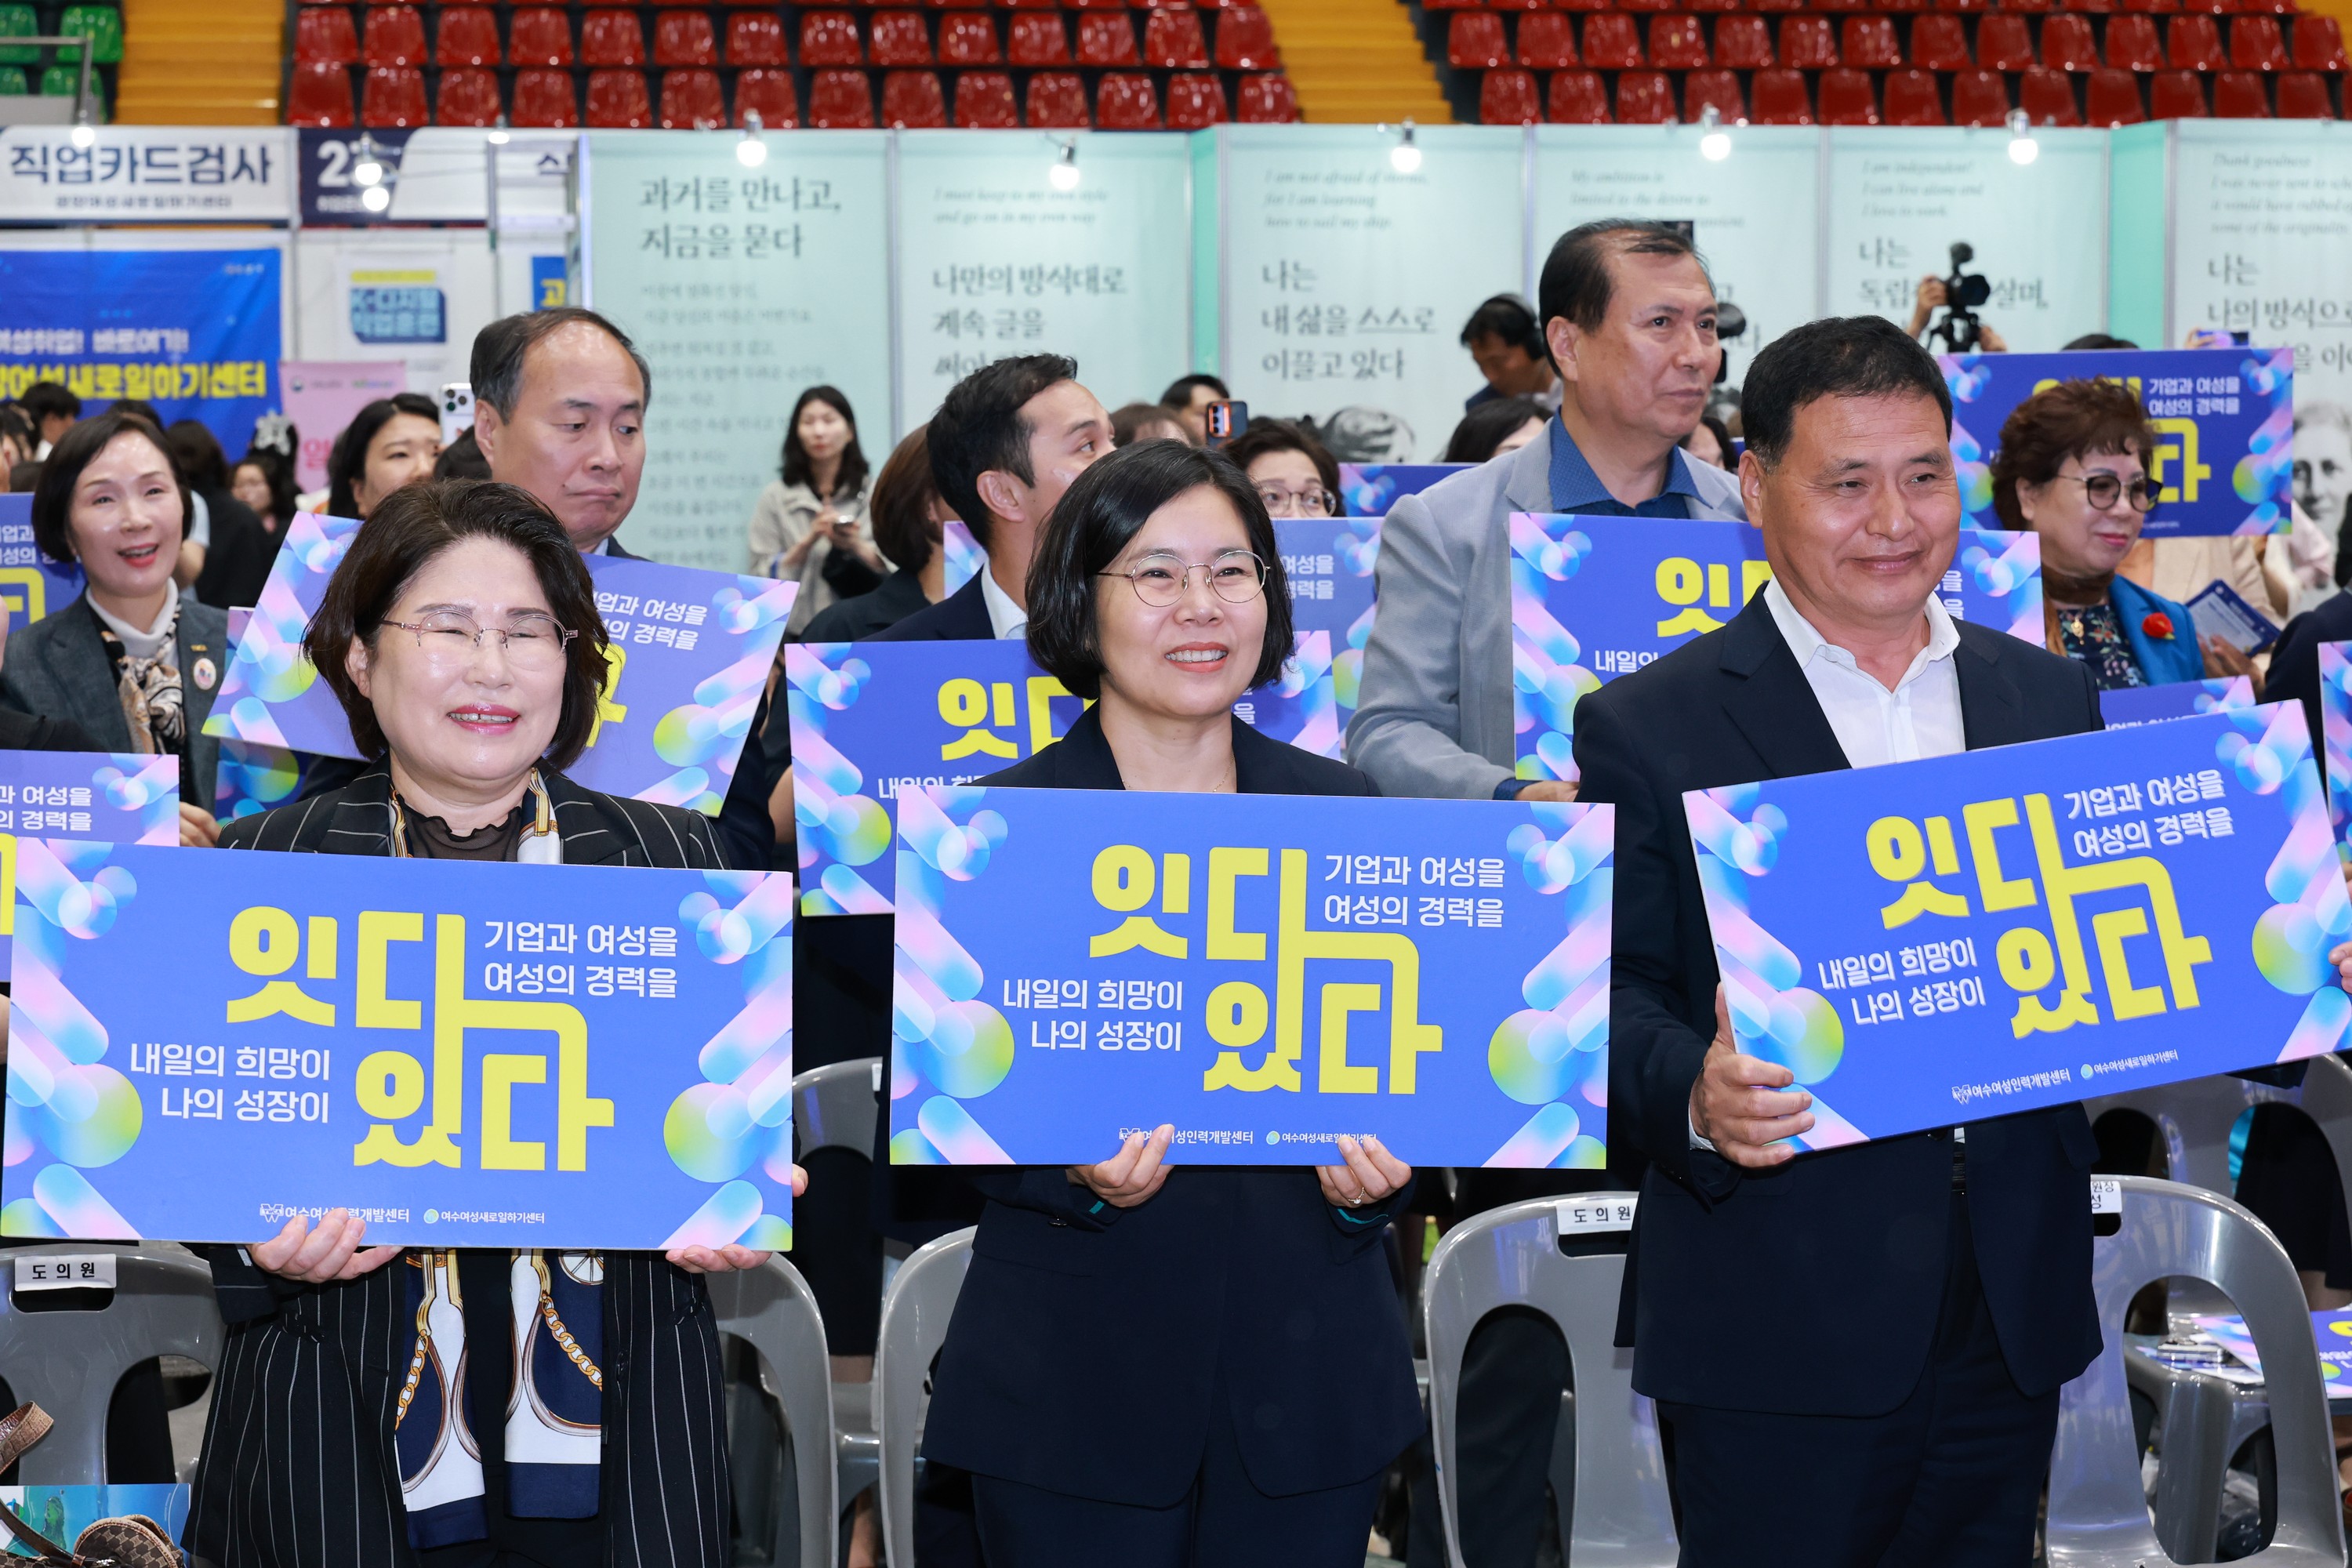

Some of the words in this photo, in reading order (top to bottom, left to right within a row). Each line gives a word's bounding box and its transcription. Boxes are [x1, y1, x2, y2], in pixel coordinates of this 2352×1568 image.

[11, 145, 273, 185] 직업카드검사
[640, 177, 732, 212] 과거를
[742, 177, 841, 212] 만나고,
[641, 223, 733, 260] 지금을
[744, 223, 803, 260] 묻다
[1859, 237, 1911, 269] 나는
[933, 263, 1013, 296] 나만의
[1019, 263, 1127, 296] 방식대로
[1262, 260, 1318, 291] 나는
[2208, 252, 2259, 286] 나는
[934, 309, 986, 339] 계속
[993, 309, 1046, 339] 글을
[1356, 307, 1438, 335] 스스로
[2208, 298, 2258, 328] 나의
[2264, 298, 2352, 331] 방식으
[1262, 349, 1345, 380] 이끌고
[1351, 349, 1406, 380] 있다
[0, 361, 267, 401] 여성새로일하기센터
[2149, 378, 2193, 396] 기업과
[2149, 399, 2193, 416] 여성의
[0, 524, 34, 543] 업과
[0, 546, 36, 564] 성의
[593, 591, 639, 615] 업과
[643, 599, 708, 626] 여성을
[633, 623, 699, 651] 경력을
[23, 786, 93, 807] 여성을
[2063, 782, 2143, 820] 기업과
[2147, 769, 2227, 807] 여성을
[22, 811, 93, 832] 경력을
[2073, 820, 2152, 858] 여성의
[2154, 806, 2235, 846] 경력을
[1325, 855, 1412, 886] 기업과
[1420, 857, 1505, 887] 여성을
[1324, 895, 1408, 926] 여성의
[1418, 897, 1504, 927] 경력을
[485, 921, 578, 954] 기업과
[587, 924, 678, 958] 여성을
[1817, 950, 1896, 990] 내일의
[1898, 937, 1978, 978] 희망이
[485, 962, 575, 996] 여성의
[586, 966, 677, 998] 경력을
[1004, 978, 1088, 1010] 내일의
[1098, 979, 1182, 1011] 희망이
[1851, 989, 1905, 1025] 나의
[1908, 976, 1987, 1017] 성장이
[1031, 1020, 1087, 1051] 나의
[1096, 1021, 1181, 1051] 성장이
[130, 1043, 225, 1077] 내일의
[235, 1046, 330, 1081] 희망이
[2094, 1049, 2179, 1074] 여수여성새로일하기센터
[1972, 1068, 2071, 1098] 여수여성인력개발센터
[162, 1087, 223, 1120] 나의
[234, 1090, 328, 1123] 성장이
[1142, 1131, 1254, 1145] 여성인력개발센터
[1282, 1132, 1377, 1145] 여수여성새로일기센터
[285, 1206, 410, 1223] 여수여력개발센터
[441, 1210, 545, 1224] 여수여성새로일하기센터
